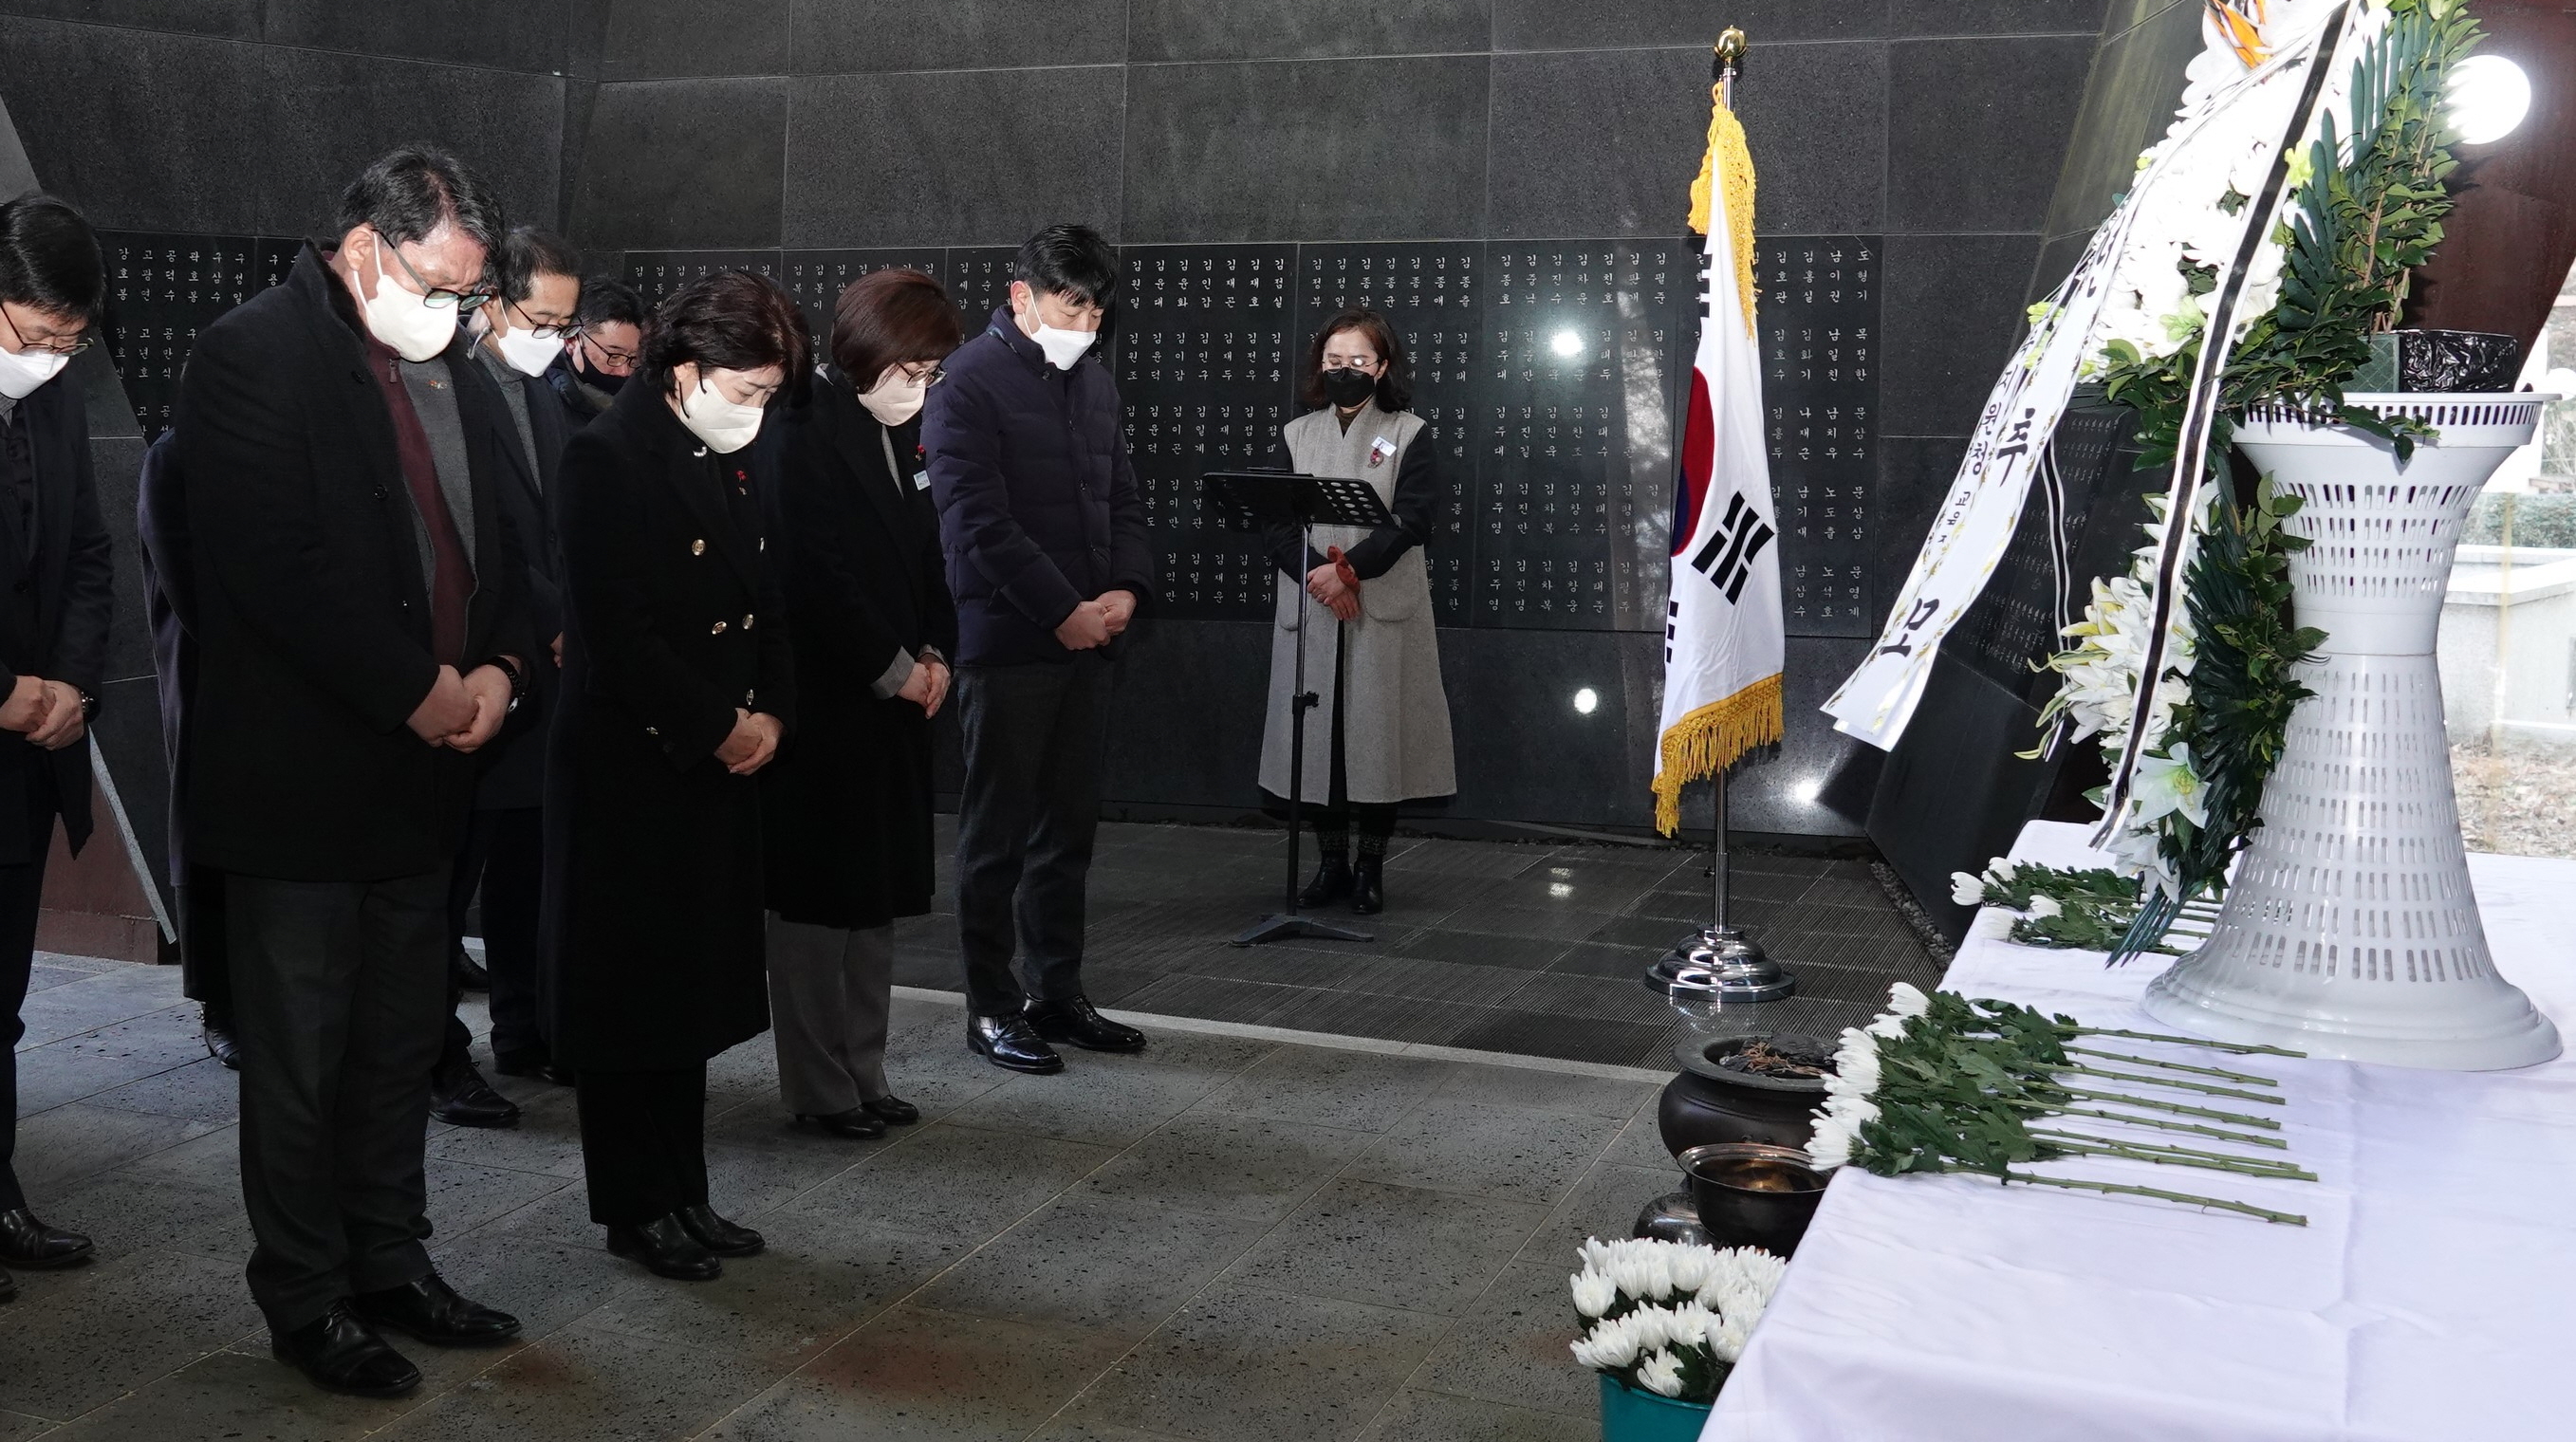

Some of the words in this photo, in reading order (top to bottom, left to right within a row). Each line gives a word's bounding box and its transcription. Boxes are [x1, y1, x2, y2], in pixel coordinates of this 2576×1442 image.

[117, 247, 130, 301] 강호봉
[140, 250, 154, 302] 고광연
[210, 251, 223, 304] 구삼수
[232, 252, 246, 305] 구성일
[812, 264, 825, 311] 김봉이
[957, 261, 969, 310] 김세갑
[980, 261, 991, 310] 김순명
[1130, 259, 1141, 309] 김원일
[1154, 259, 1165, 308] 김윤대
[1177, 259, 1189, 307] 김윤화
[1201, 258, 1213, 308] 김인갑
[1224, 258, 1236, 308] 김재곤
[1248, 258, 1260, 307] 김재호
[1273, 258, 1285, 309] 김점실
[1310, 258, 1323, 307] 김정부
[1334, 257, 1346, 308] 김정일
[1360, 257, 1372, 308] 김종갑
[1383, 257, 1397, 308] 김종균
[1433, 256, 1446, 306] 김종애
[1498, 254, 1511, 305] 김종호
[1549, 253, 1563, 305] 김진수
[1774, 250, 1788, 305] 김호관
[1829, 250, 1843, 304] 남이권
[1857, 250, 1870, 302] 도형기
[161, 327, 174, 379] 공만식
[1126, 332, 1139, 380] 김원조
[1174, 331, 1186, 382] 김이갑
[1197, 331, 1210, 381] 김인구
[1221, 332, 1233, 381] 김재두
[1245, 331, 1257, 381] 김전우
[1269, 331, 1281, 382] 김점용
[1455, 331, 1469, 382] 김종태
[1496, 330, 1510, 380] 김주대
[1599, 329, 1612, 381] 김태두
[1773, 328, 1786, 381] 김호수
[1855, 327, 1868, 381] 목정한
[1171, 405, 1182, 455] 김이곤
[1218, 405, 1230, 456] 김재만
[1454, 407, 1466, 458] 김종택
[1493, 406, 1507, 457] 김주대
[1545, 406, 1557, 457] 김진욱
[1597, 406, 1609, 457] 김태수
[1798, 406, 1812, 461] 나재근
[1825, 406, 1840, 459] 남치우
[1852, 406, 1866, 460] 문삼수
[1145, 478, 1157, 527] 김윤도
[1168, 478, 1179, 529] 김이만
[1192, 478, 1203, 529] 김일관
[1450, 483, 1463, 534] 김종택
[1491, 482, 1504, 535] 김주영
[1517, 482, 1529, 535] 김진만
[1568, 483, 1582, 534] 김창수
[1594, 483, 1606, 535] 김태수
[1797, 485, 1810, 538] 남기재
[1851, 486, 1864, 540] 문상삼
[1165, 552, 1177, 602] 김익만
[1189, 552, 1200, 601] 김일기
[1238, 553, 1249, 603] 김점식
[1448, 558, 1460, 611] 김종한
[1488, 559, 1501, 611] 김주영
[1566, 560, 1579, 613] 김창웅
[1592, 561, 1604, 614] 김태준
[1793, 564, 1807, 618] 남삼수
[1821, 565, 1835, 618] 노석호
